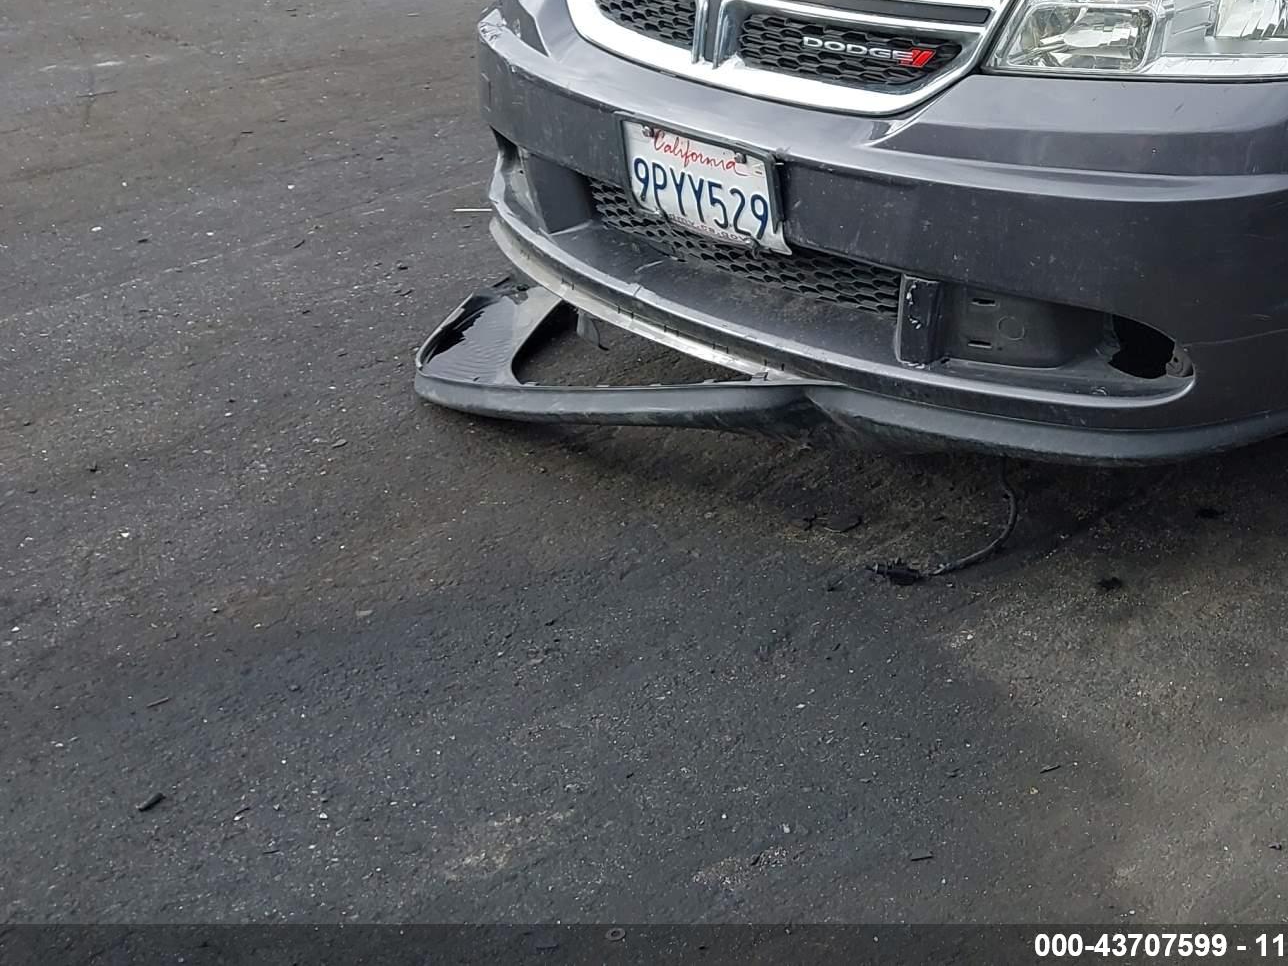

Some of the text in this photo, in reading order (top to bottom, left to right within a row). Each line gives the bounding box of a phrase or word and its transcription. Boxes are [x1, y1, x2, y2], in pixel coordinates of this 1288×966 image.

[803, 36, 914, 62] DODGE
[653, 128, 748, 176] California
[633, 157, 770, 240] 9PYY529
